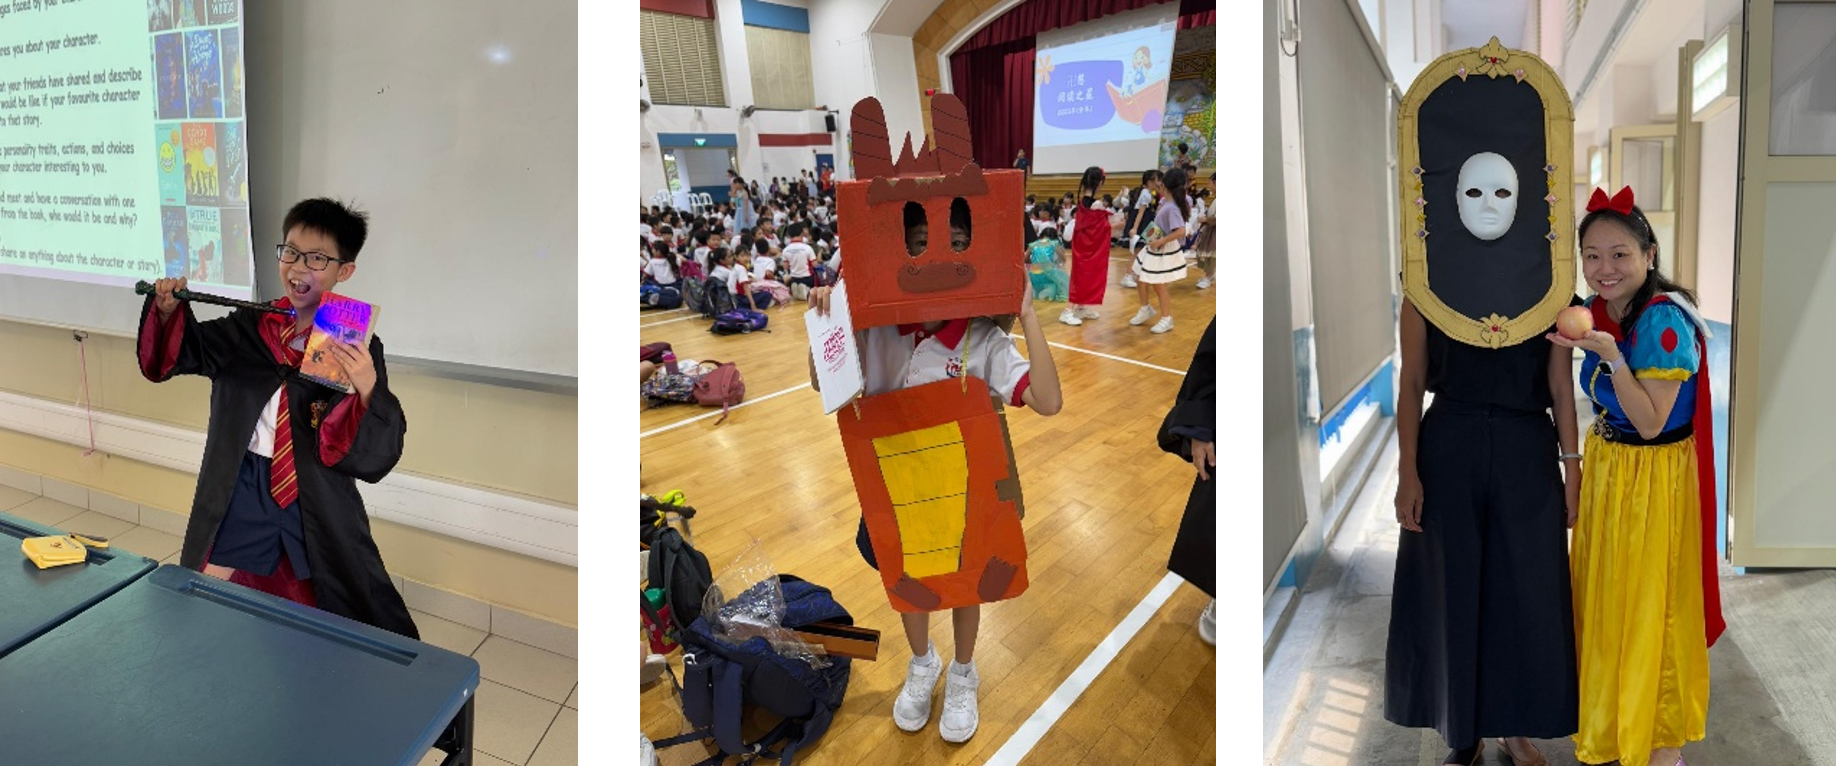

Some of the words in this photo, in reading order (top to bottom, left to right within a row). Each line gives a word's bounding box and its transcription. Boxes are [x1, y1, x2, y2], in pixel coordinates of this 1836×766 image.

[13, 45, 23, 58] you
[26, 40, 43, 53] about
[46, 40, 60, 54] your
[63, 33, 101, 48] character.
[7, 81, 21, 95] your
[23, 76, 46, 91] friends
[49, 75, 64, 88] have
[66, 70, 90, 86] shared
[93, 69, 105, 84] and
[108, 67, 142, 82] describe
[1, 96, 17, 109] would
[19, 96, 26, 108] be
[29, 94, 40, 107] like
[42, 93, 48, 107] if
[50, 95, 65, 110] your
[67, 90, 99, 105] favourite
[102, 89, 140, 102] character
[23, 114, 42, 128] story.
[4, 143, 36, 159] personality
[38, 142, 60, 157] traits,
[62, 142, 88, 157] actions,
[92, 141, 104, 154] and
[107, 140, 134, 155] choices
[13, 160, 42, 172] character
[44, 160, 79, 176] interesting
[82, 161, 90, 173] to
[92, 163, 107, 177] you.
[7, 193, 21, 203] meet
[23, 191, 35, 204] and
[36, 191, 51, 204] have
[53, 195, 58, 205] a
[60, 194, 102, 206] conversation
[104, 194, 120, 207] with
[122, 197, 136, 208] one
[1, 206, 16, 219] from
[18, 207, 28, 220] the
[29, 207, 47, 223] book,
[49, 208, 61, 221] who
[63, 209, 82, 222] would
[84, 211, 90, 223] it
[92, 210, 101, 224] be
[104, 211, 117, 225] and
[120, 212, 138, 229] why?
[29, 249, 54, 265] anything
[56, 250, 74, 264] about
[76, 252, 88, 265] the
[91, 253, 124, 269] character
[127, 260, 134, 270] or
[138, 259, 163, 275] story).
[321, 303, 366, 325] POTTER
[325, 294, 367, 314] HARRY
